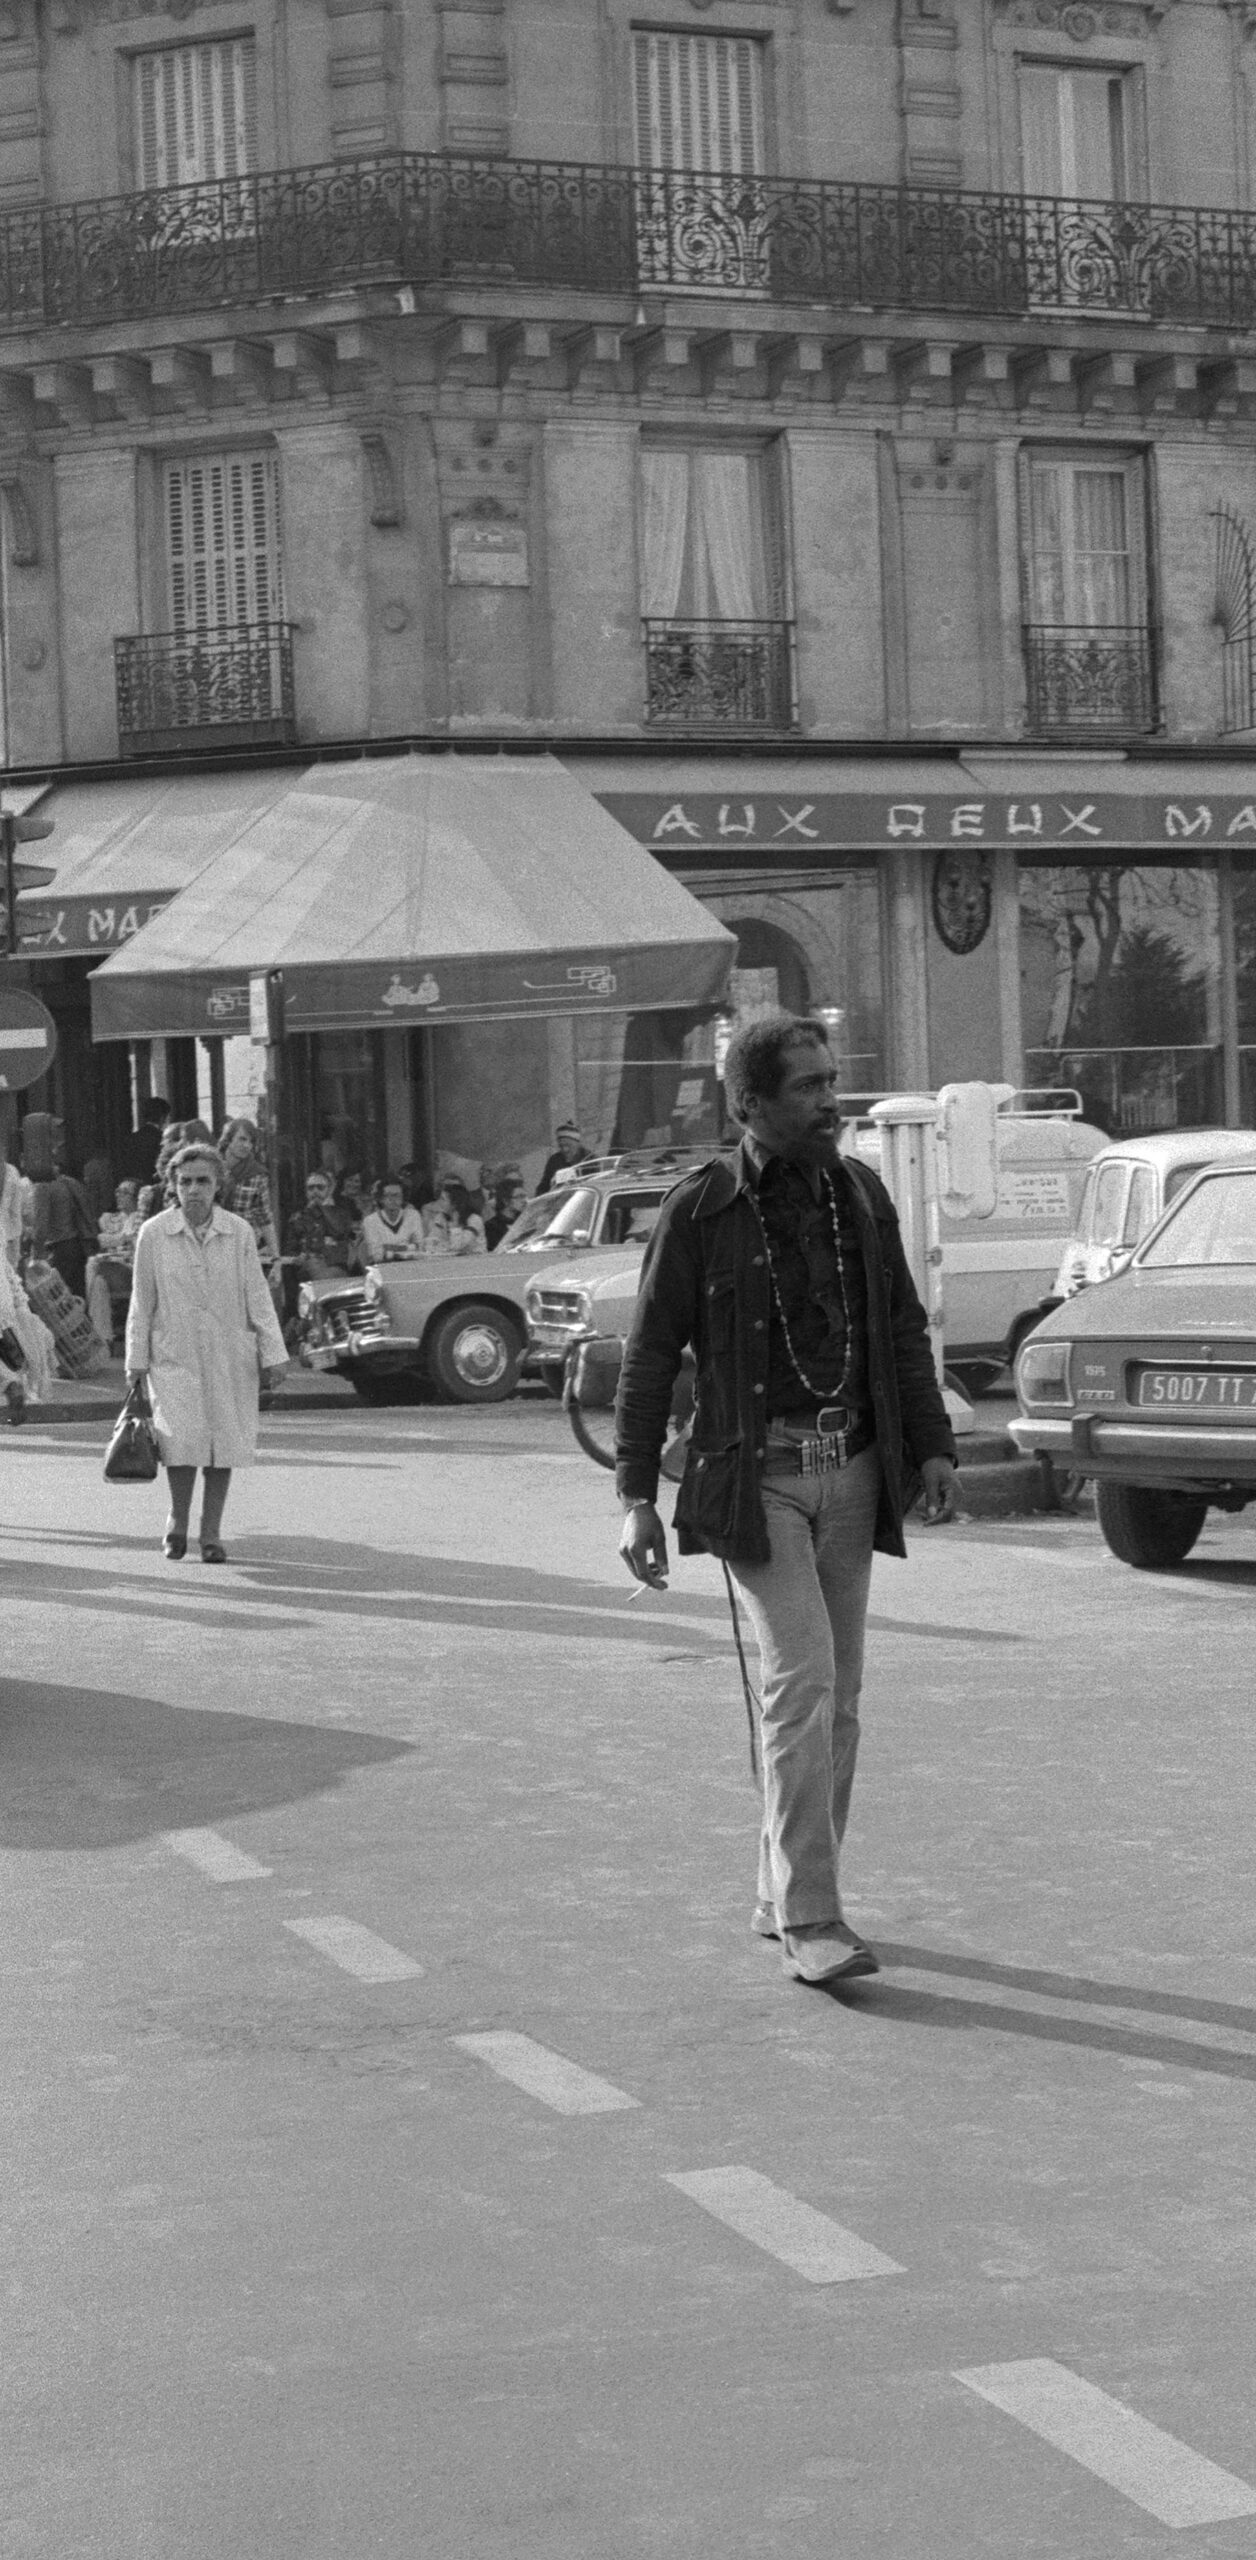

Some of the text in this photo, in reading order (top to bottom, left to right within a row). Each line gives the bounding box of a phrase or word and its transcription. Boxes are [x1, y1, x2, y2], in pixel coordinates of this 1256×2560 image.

[652, 803, 820, 838] AUX
[886, 803, 1102, 838] DEUX
[1152, 1376, 1209, 1402] 5007
[1217, 1377, 1245, 1403] TT
